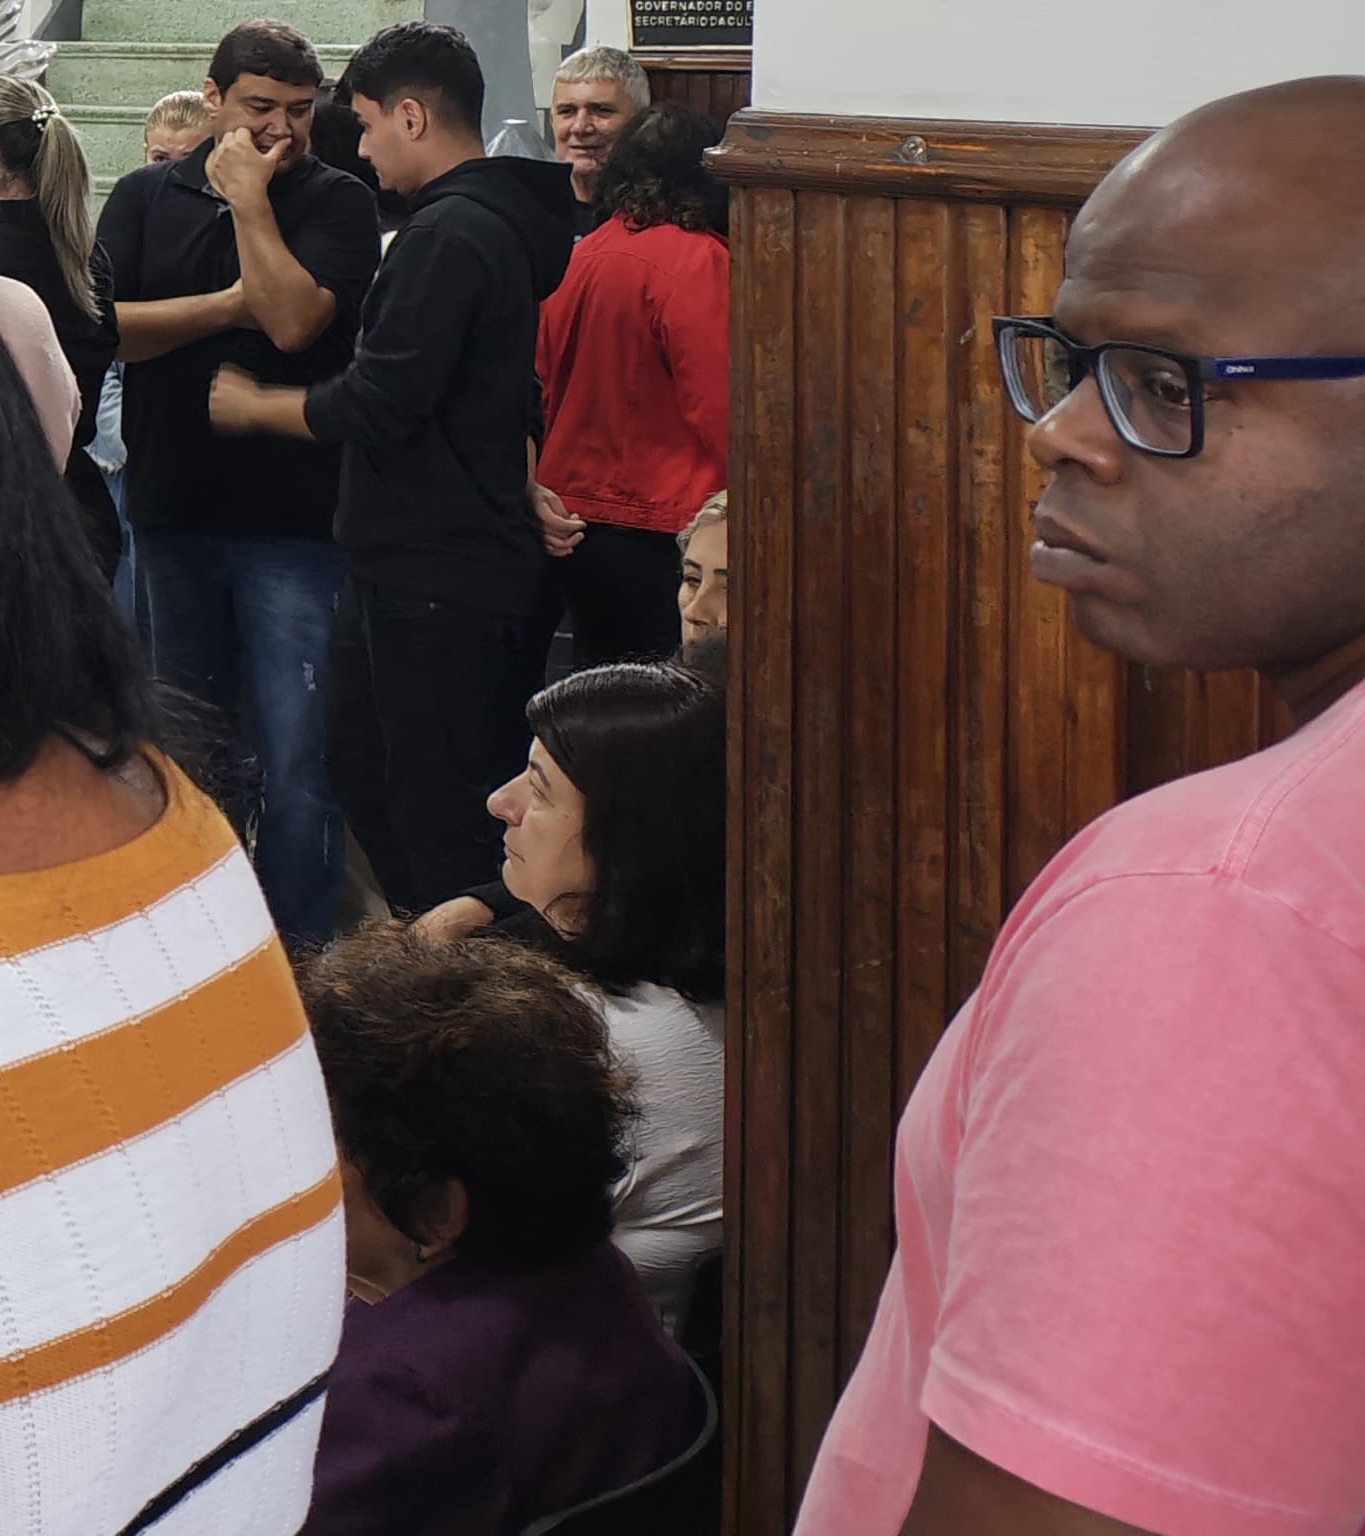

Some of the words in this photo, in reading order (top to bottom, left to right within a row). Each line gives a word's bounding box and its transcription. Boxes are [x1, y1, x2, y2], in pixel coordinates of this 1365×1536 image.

[635, 1, 722, 12] GOVERNADOR
[726, 1, 743, 11] DO
[635, 12, 708, 27] SECRETÁRIO
[710, 15, 726, 26] DA
